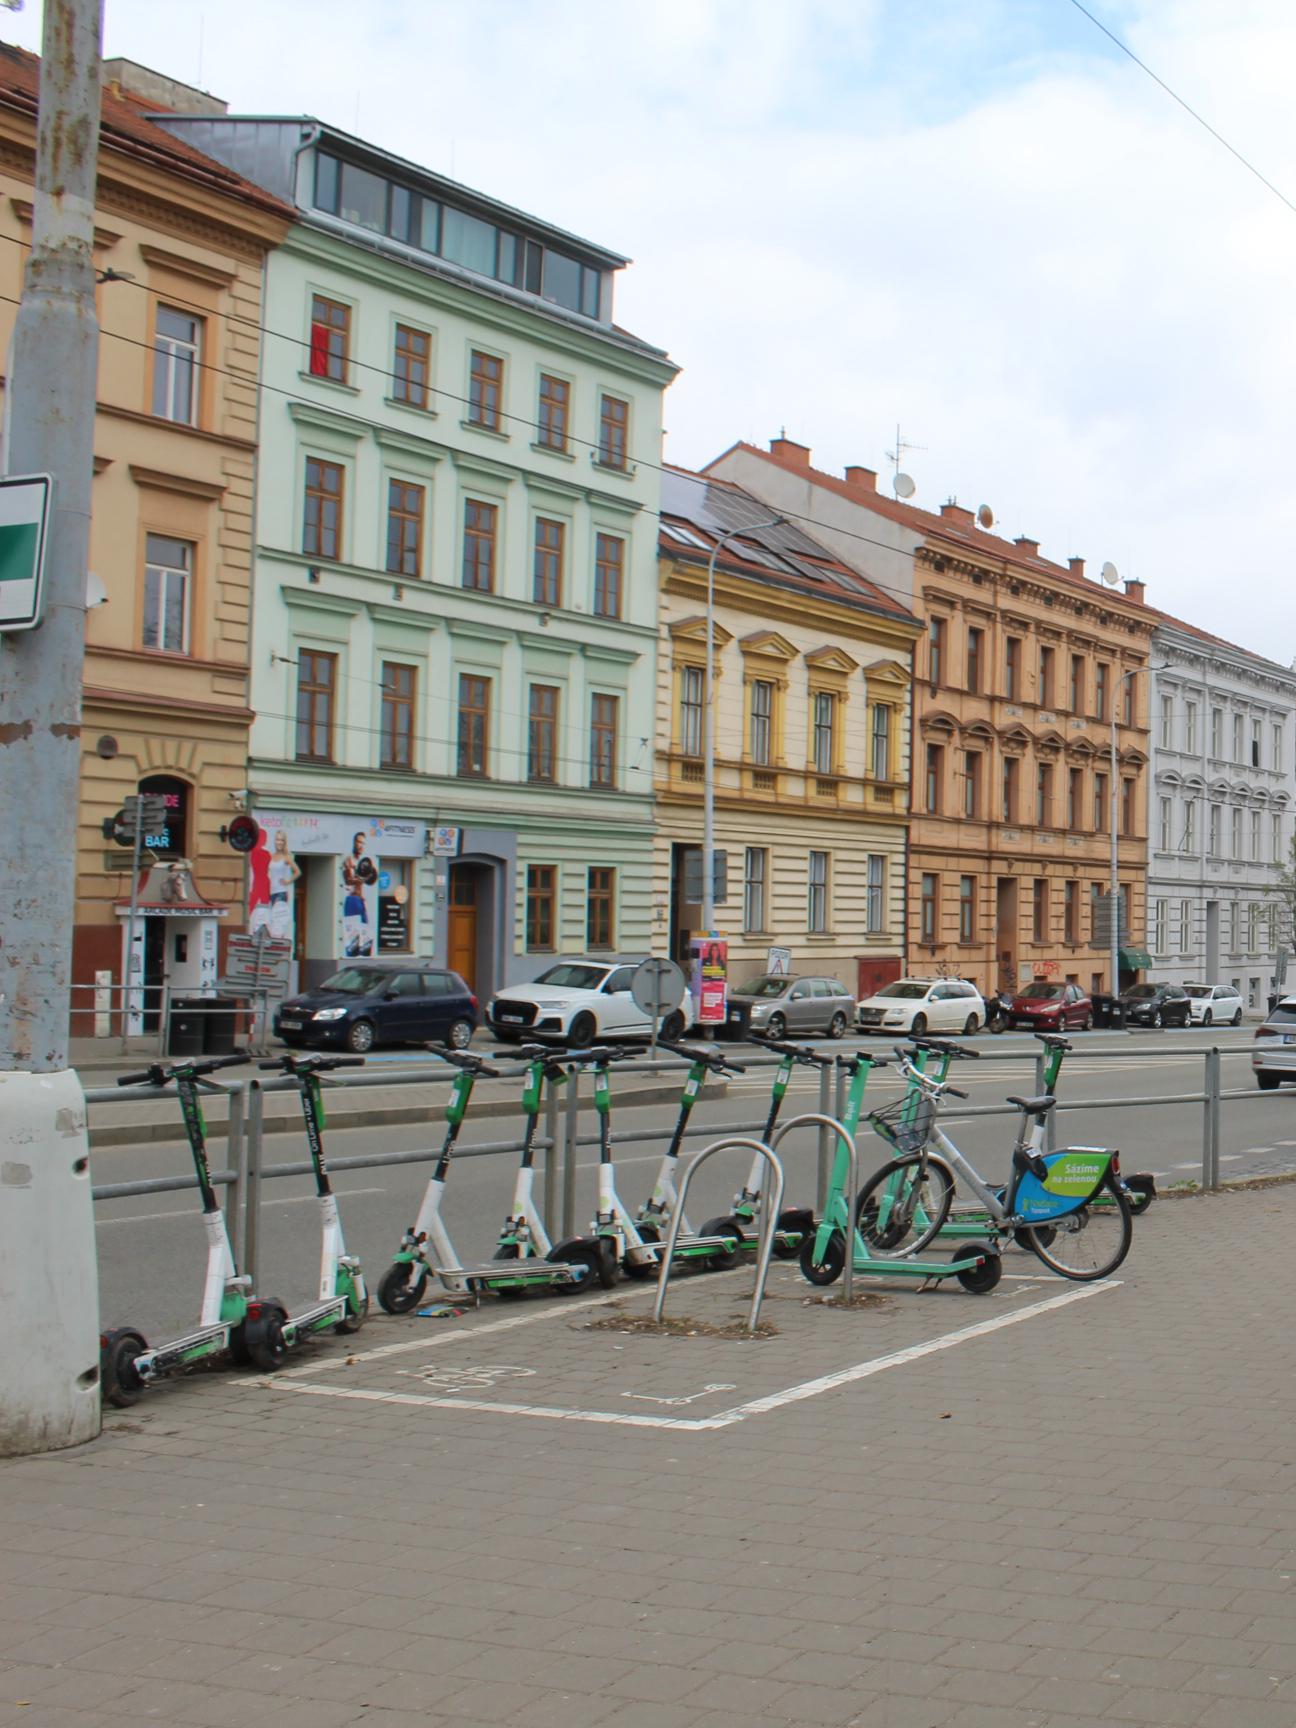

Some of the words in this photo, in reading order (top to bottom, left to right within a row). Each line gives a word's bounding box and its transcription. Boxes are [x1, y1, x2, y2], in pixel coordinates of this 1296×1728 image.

[145, 836, 170, 848] BAR
[1064, 1163, 1100, 1175] Sázíme
[1064, 1174, 1097, 1184] zelenou
